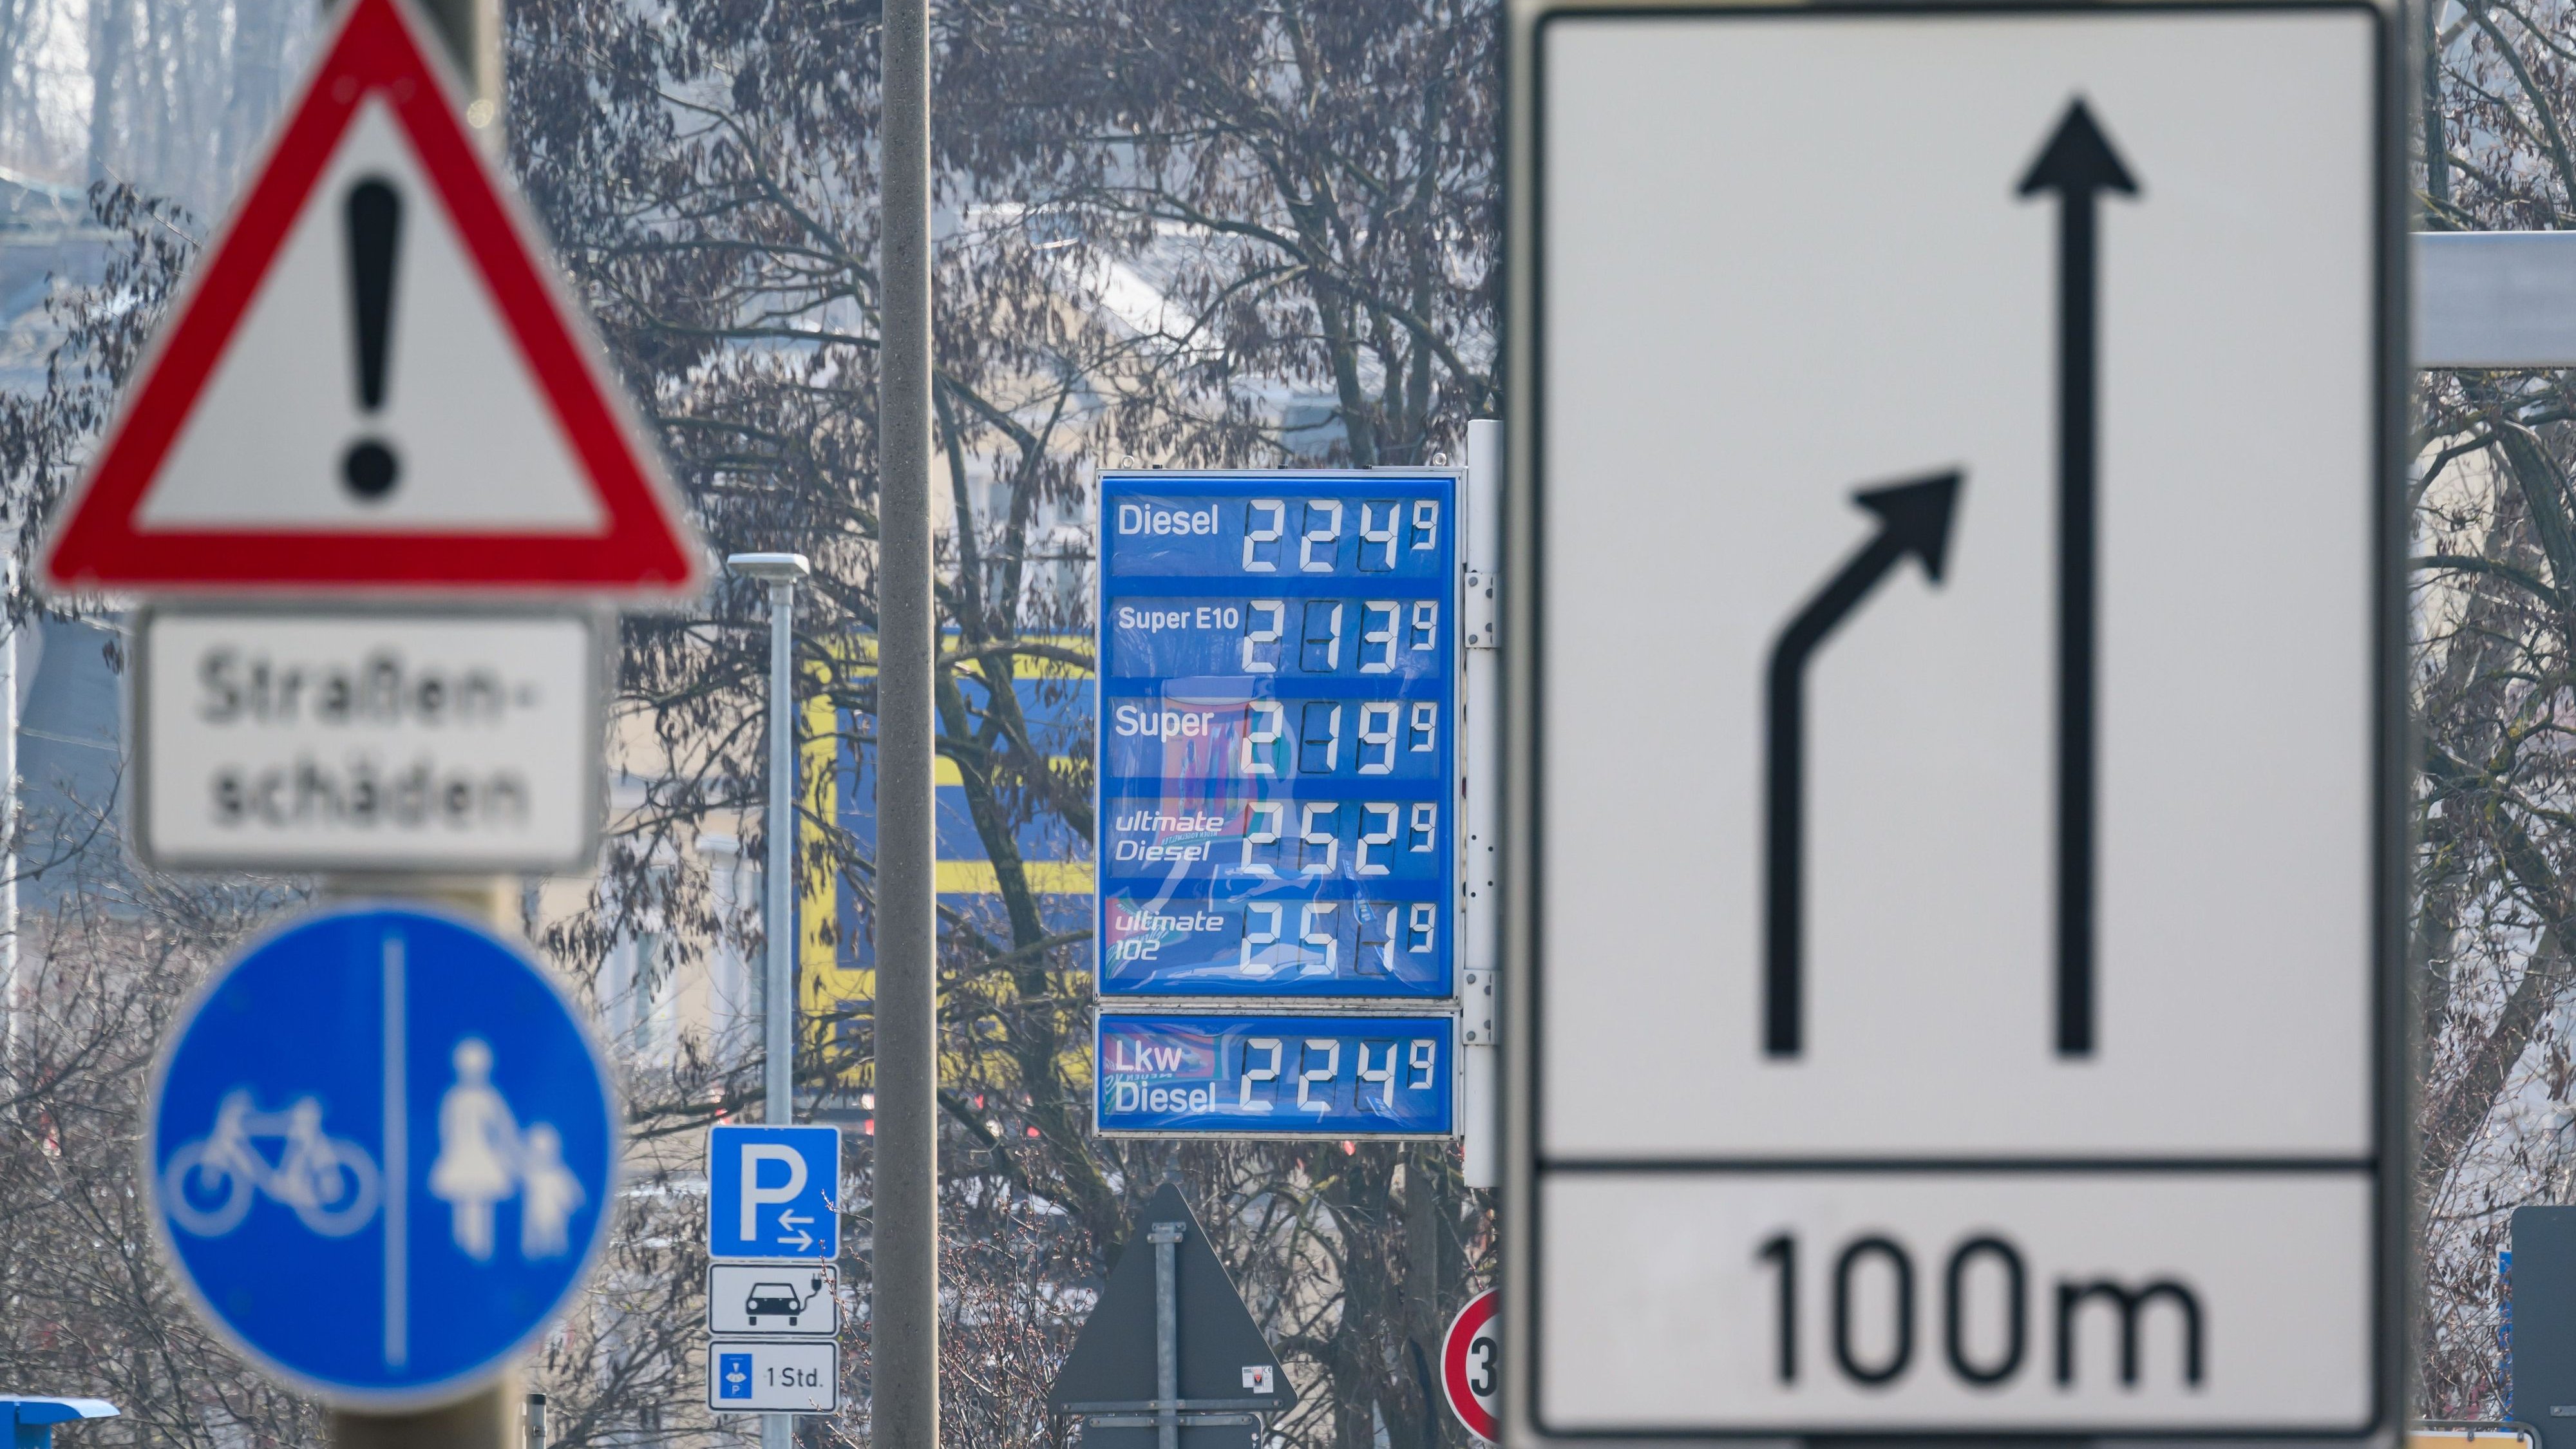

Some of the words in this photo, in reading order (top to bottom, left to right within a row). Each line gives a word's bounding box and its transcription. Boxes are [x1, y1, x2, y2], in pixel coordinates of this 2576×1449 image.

[1119, 504, 1218, 535] Diesel
[1119, 607, 1191, 633] Super
[1197, 607, 1238, 629] E10
[198, 648, 538, 724] Straßen-
[1115, 705, 1215, 743] Super
[209, 752, 529, 828] schäden
[1115, 810, 1224, 832] ultimate
[1115, 840, 1211, 862] Diesel
[1115, 910, 1224, 932] ultimate
[1115, 940, 1160, 961] 102
[1116, 1039, 1182, 1072] Lkw
[1115, 1080, 1216, 1113] Diesel
[740, 1144, 808, 1241] P
[1755, 1231, 2206, 1390] 100m
[767, 1367, 774, 1387] 1
[781, 1367, 824, 1388] Std.
[1471, 1336, 1498, 1397] 3
